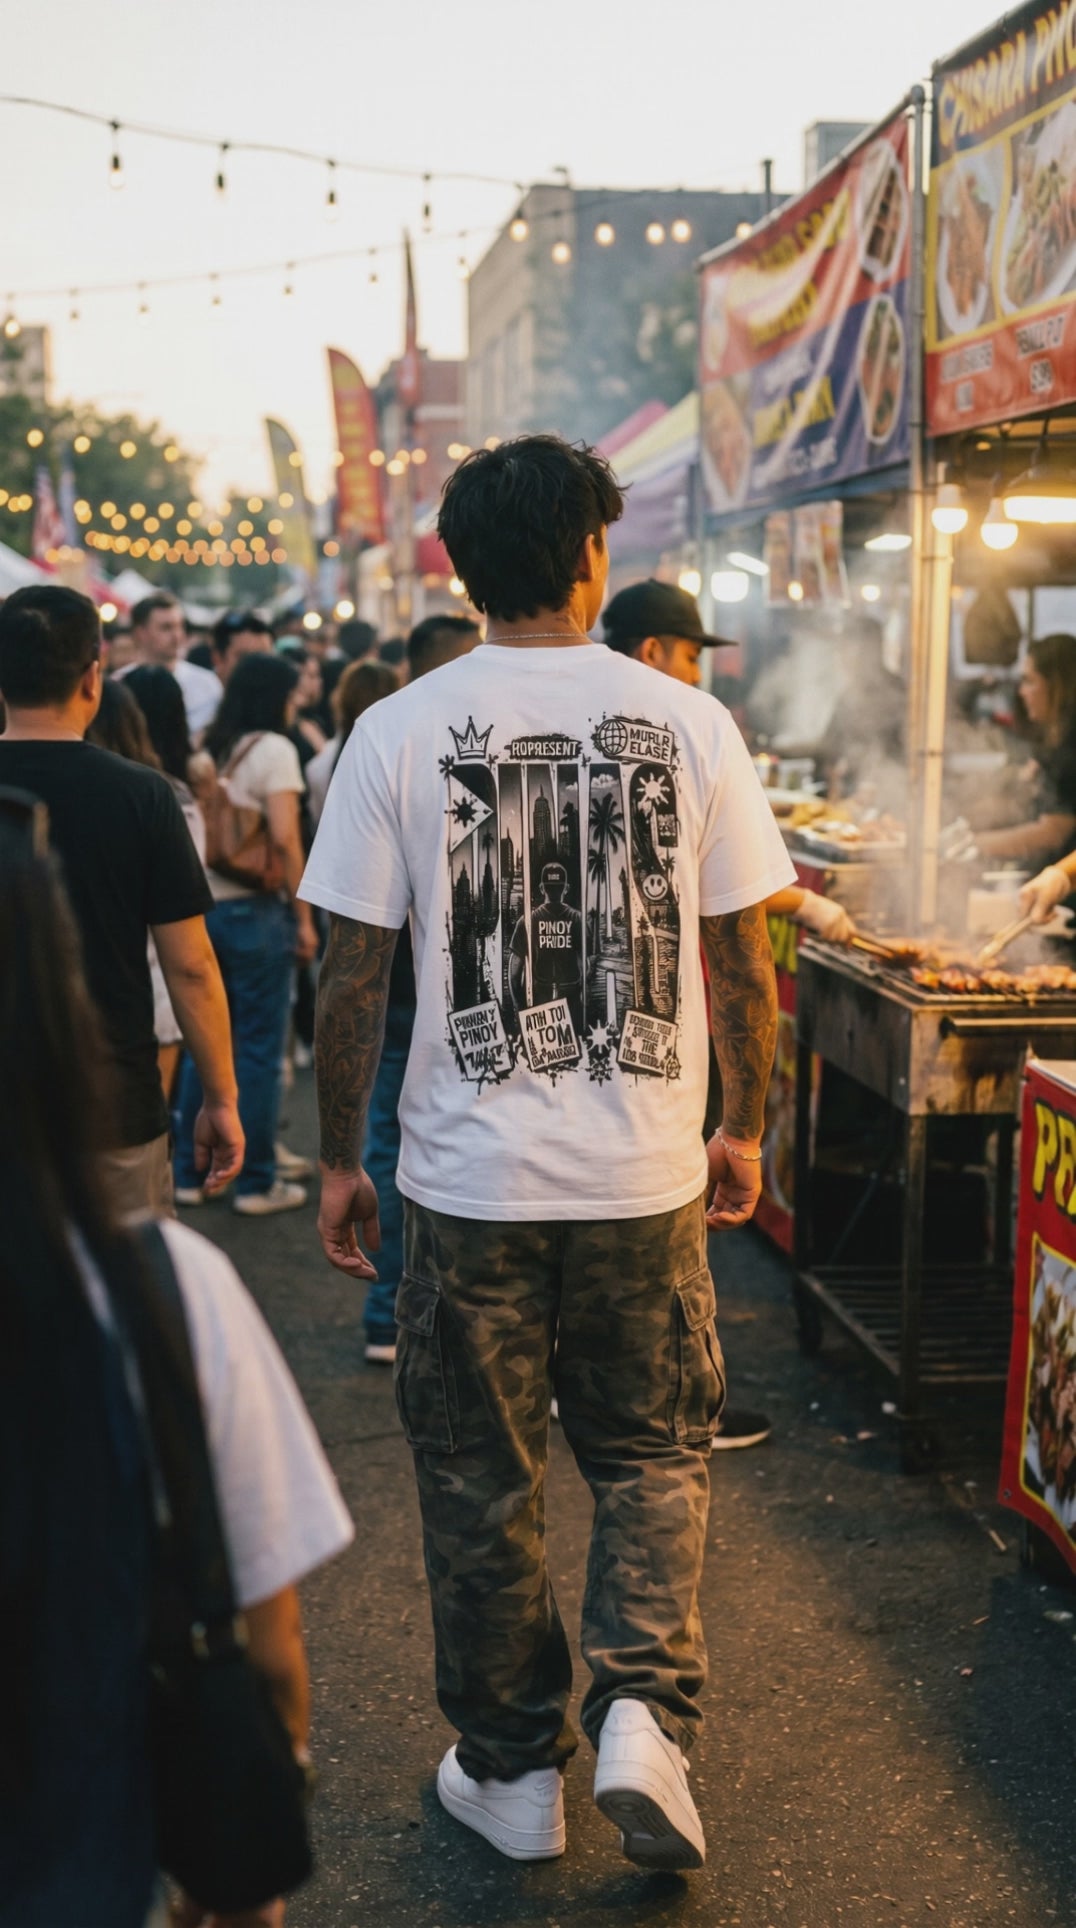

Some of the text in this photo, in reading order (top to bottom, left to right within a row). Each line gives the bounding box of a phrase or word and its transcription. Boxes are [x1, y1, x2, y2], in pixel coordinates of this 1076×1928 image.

[538, 920, 572, 935] PINOY
[539, 935, 572, 949] PRIDE
[459, 1021, 498, 1048] PINOY
